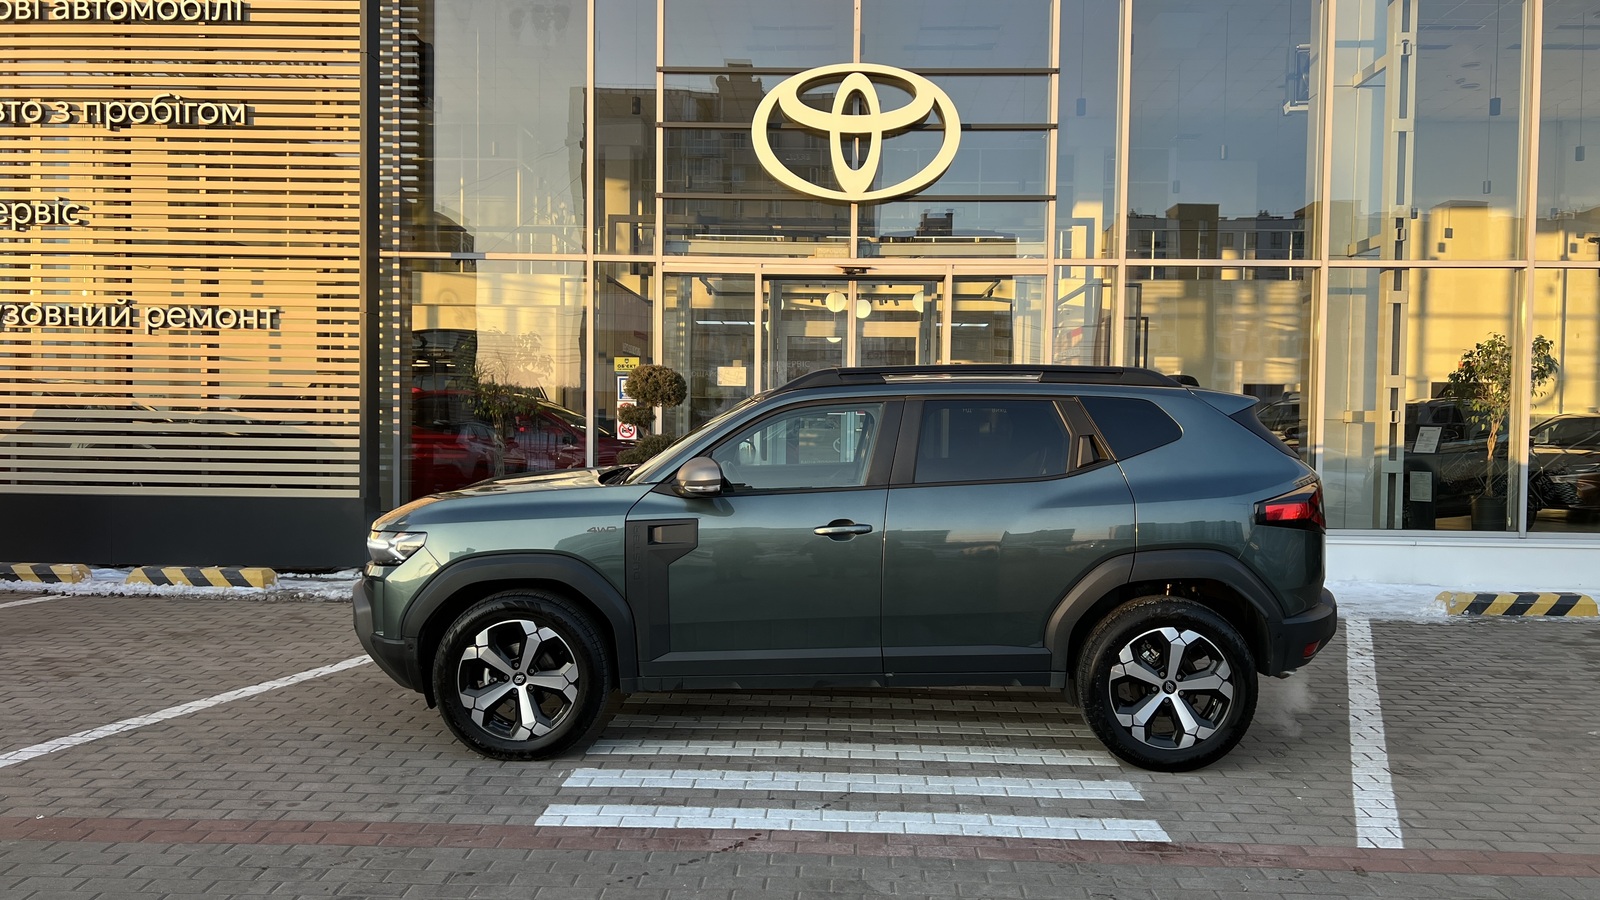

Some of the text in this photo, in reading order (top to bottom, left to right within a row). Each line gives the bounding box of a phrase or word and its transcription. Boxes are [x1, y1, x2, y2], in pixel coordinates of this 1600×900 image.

[52, 0, 242, 21] автомобілі
[54, 101, 71, 123] з
[83, 93, 246, 130] пробігом
[0, 298, 278, 335] зовний ремонт
[586, 525, 617, 533] 4WD
[632, 524, 641, 581] DUSTER
